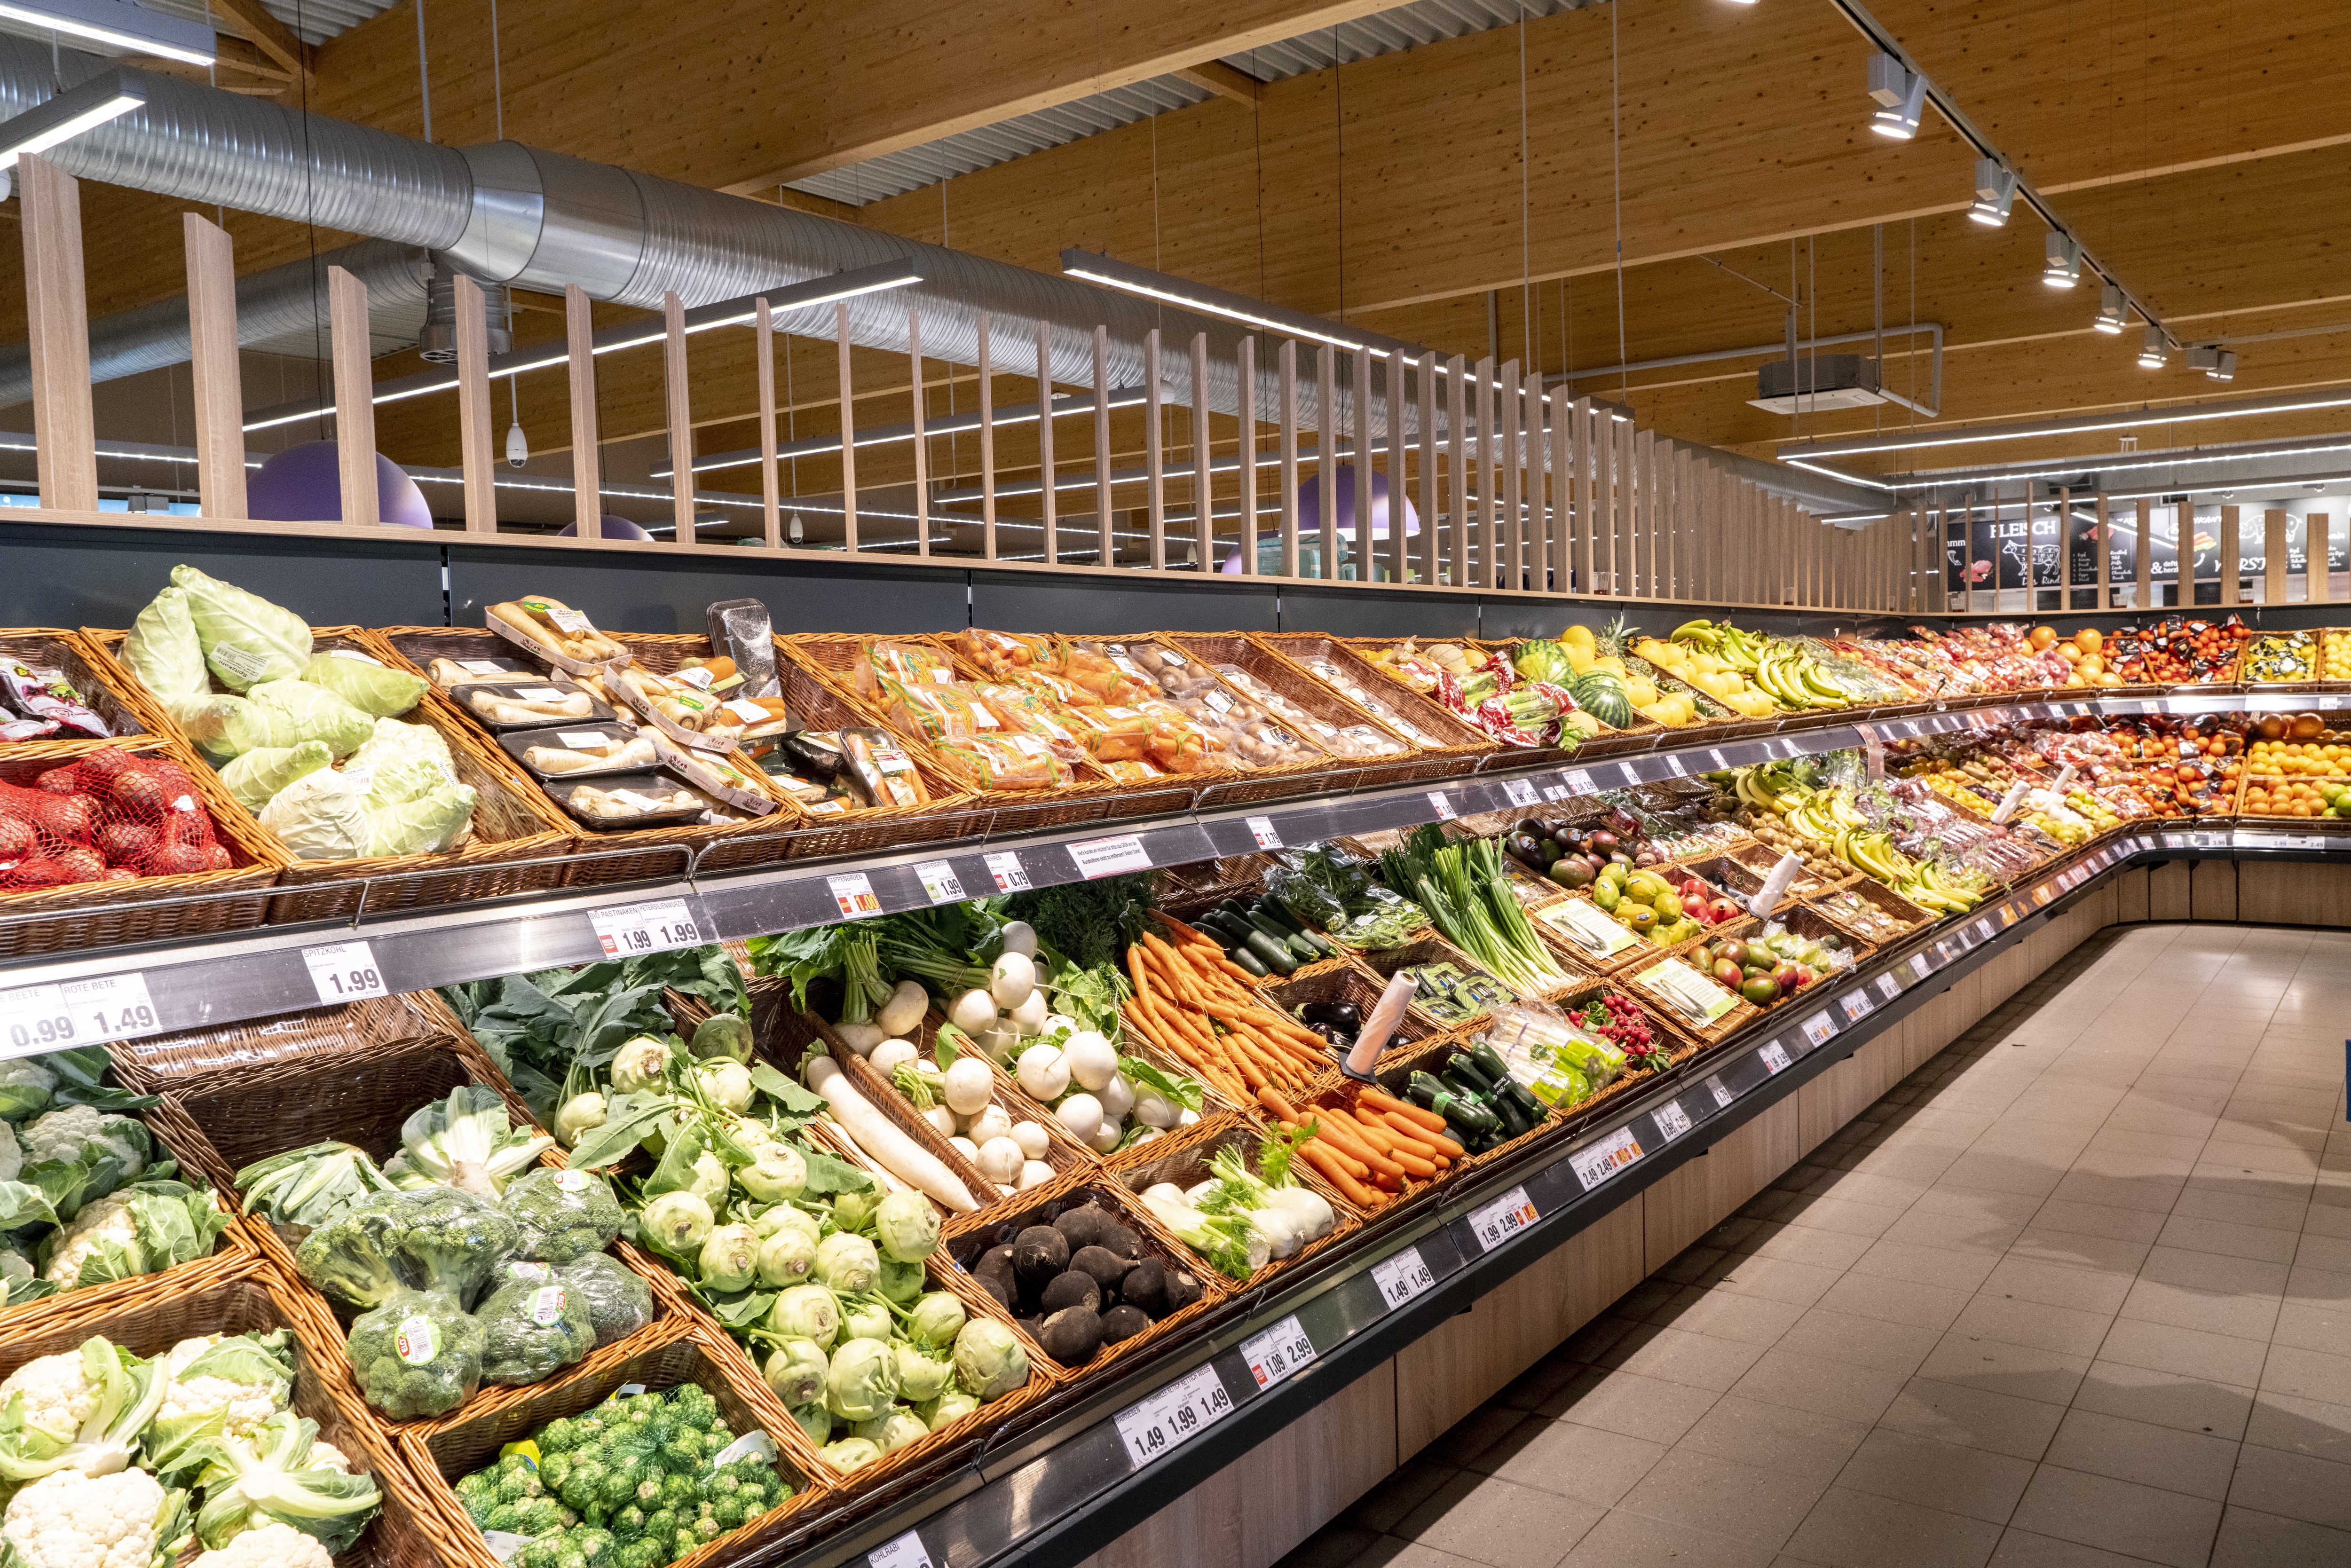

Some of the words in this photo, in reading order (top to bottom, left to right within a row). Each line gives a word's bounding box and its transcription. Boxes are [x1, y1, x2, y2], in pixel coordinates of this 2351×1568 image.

[218, 660, 247, 678] Spitzkohl
[343, 767, 366, 776] pitzkohl
[438, 761, 456, 786] Spitzkohl
[1513, 793, 1526, 804] 1.99
[1526, 791, 1539, 801] 1.99
[1443, 805, 1454, 815] 1.49
[1265, 832, 1280, 844] 1.79
[922, 860, 948, 870] SUPPENGRUEN
[828, 875, 863, 883] SUPPENGRUEN
[940, 879, 962, 896] 1.99
[1008, 871, 1028, 886] 0.79
[639, 900, 686, 912] PETERSILIENWURZEL
[855, 894, 880, 911] 1.00
[589, 911, 600, 920] BIO
[601, 907, 638, 918] PASTINAKEN
[623, 930, 652, 950] 1.99
[660, 923, 698, 944] 1.99
[303, 946, 347, 957] SPITZKOHL
[63, 982, 89, 994] ROTE
[91, 979, 117, 990] BETE
[329, 969, 380, 993] 1.99
[8, 989, 40, 1001] BEETE
[93, 1005, 154, 1034] 1.49
[10, 1016, 75, 1047] 0.99
[1493, 1077, 1507, 1089] Zucchini
[1497, 1086, 1505, 1095] Bio
[1717, 1088, 1729, 1102] 1.79
[1583, 1168, 1599, 1185] 2.49
[1597, 1158, 1613, 1176] 2.49
[1499, 1213, 1518, 1233] 2.99
[1482, 1225, 1500, 1244] 1.99
[1411, 1267, 1431, 1288] 1.49
[1388, 1280, 1409, 1302] 1.49
[1269, 1322, 1286, 1335] FENCHEL
[399, 1339, 408, 1353] ELO
[411, 1338, 420, 1360] Broccoli
[1247, 1334, 1266, 1348] MOEHREN
[1286, 1338, 1312, 1363] 2.99
[1266, 1353, 1286, 1376] 1.09
[1181, 1373, 1199, 1387] RETTICH
[1198, 1365, 1211, 1377] WEISS
[1147, 1389, 1168, 1405] SCHWARZER
[1167, 1381, 1181, 1394] RETTICH
[1200, 1388, 1229, 1416] 1.49
[1178, 1400, 1190, 1409] Kilogramm
[1115, 1406, 1141, 1425] MAIRUEBEN
[1168, 1406, 1197, 1435] 1.99
[1135, 1426, 1166, 1457] 1.49
[869, 1542, 900, 1565] KOHLRABI
